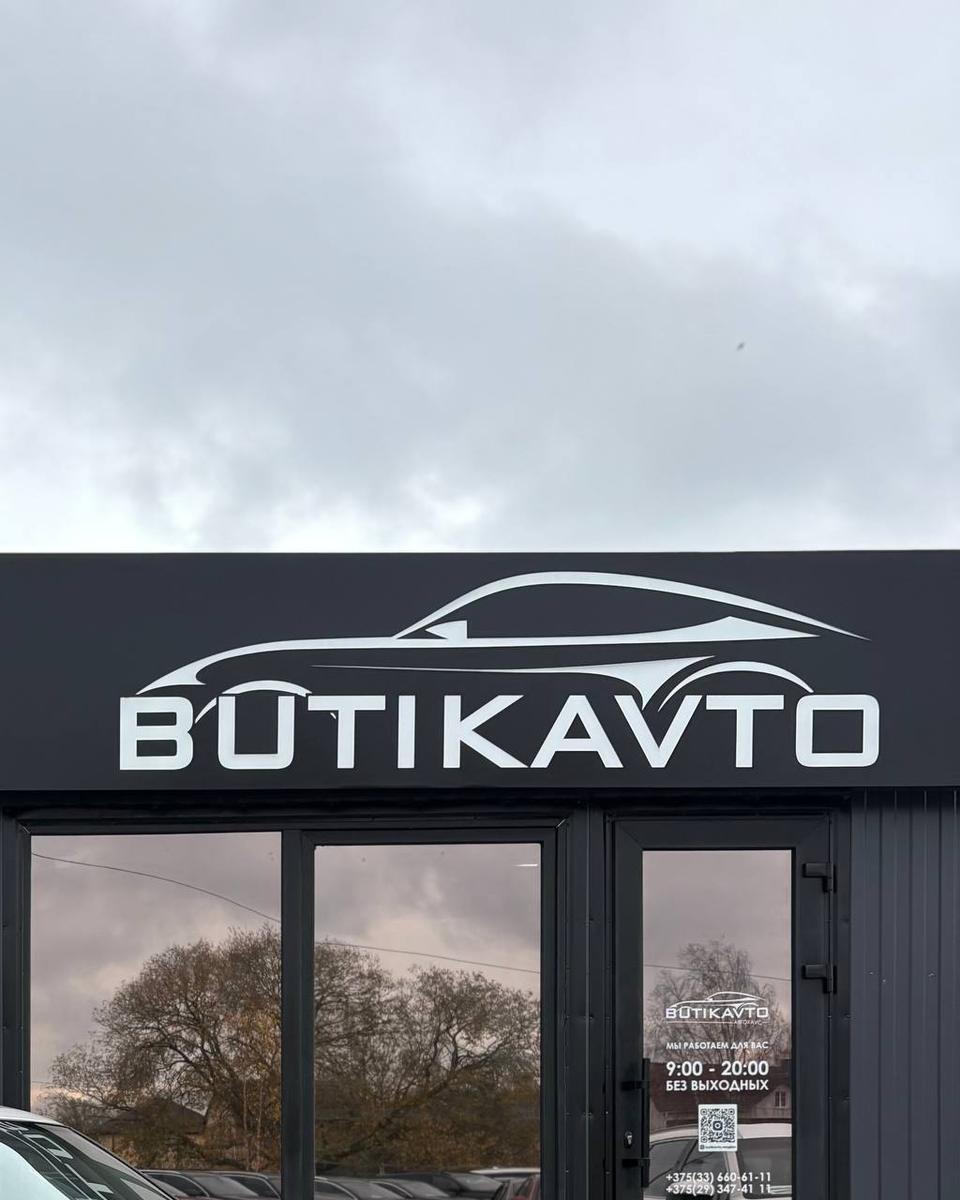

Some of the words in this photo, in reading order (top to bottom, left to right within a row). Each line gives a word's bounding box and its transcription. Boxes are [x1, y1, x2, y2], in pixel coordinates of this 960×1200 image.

[120, 694, 879, 770] BUTIKAVTO
[666, 1007, 769, 1018] BUTIKAVTO
[683, 1042, 729, 1050] РАБОТАЕМ
[730, 1042, 748, 1050] ДЛЯ
[666, 1061, 703, 1075] 9:00
[721, 1061, 769, 1075] 20:00
[666, 1080, 687, 1090] БЕЗ
[691, 1080, 769, 1091] ВЫХОДНЫХ
[666, 1172, 714, 1184] +375(33)
[717, 1172, 771, 1182] 660-61-11
[666, 1184, 715, 1196] +375(29)
